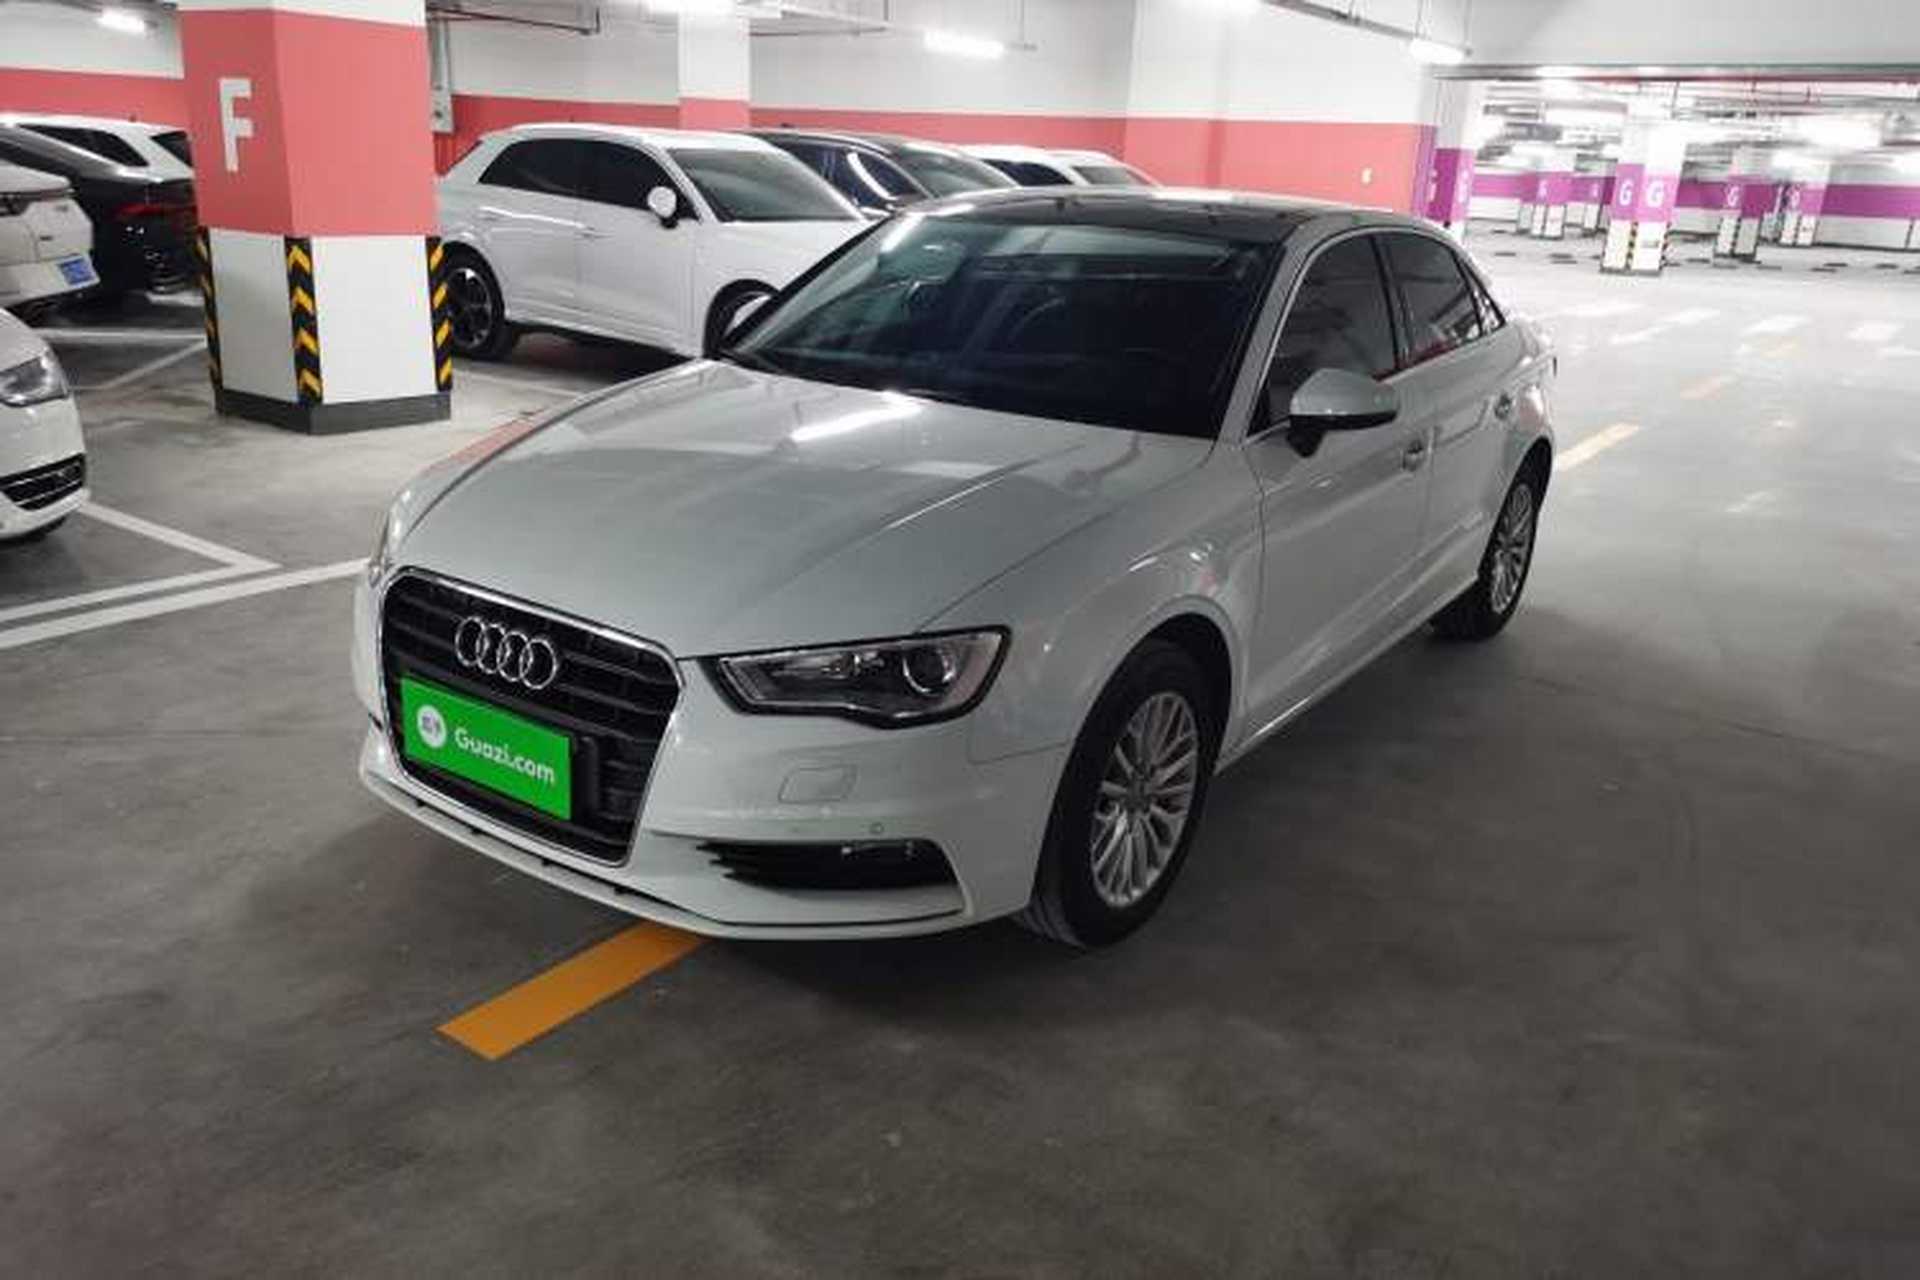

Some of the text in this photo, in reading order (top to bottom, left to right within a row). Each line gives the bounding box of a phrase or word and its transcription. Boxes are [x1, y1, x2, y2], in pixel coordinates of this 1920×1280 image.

[219, 78, 252, 172] F
[1618, 180, 1633, 206] G
[1646, 180, 1665, 207] G
[454, 726, 556, 784] Guazi.com
